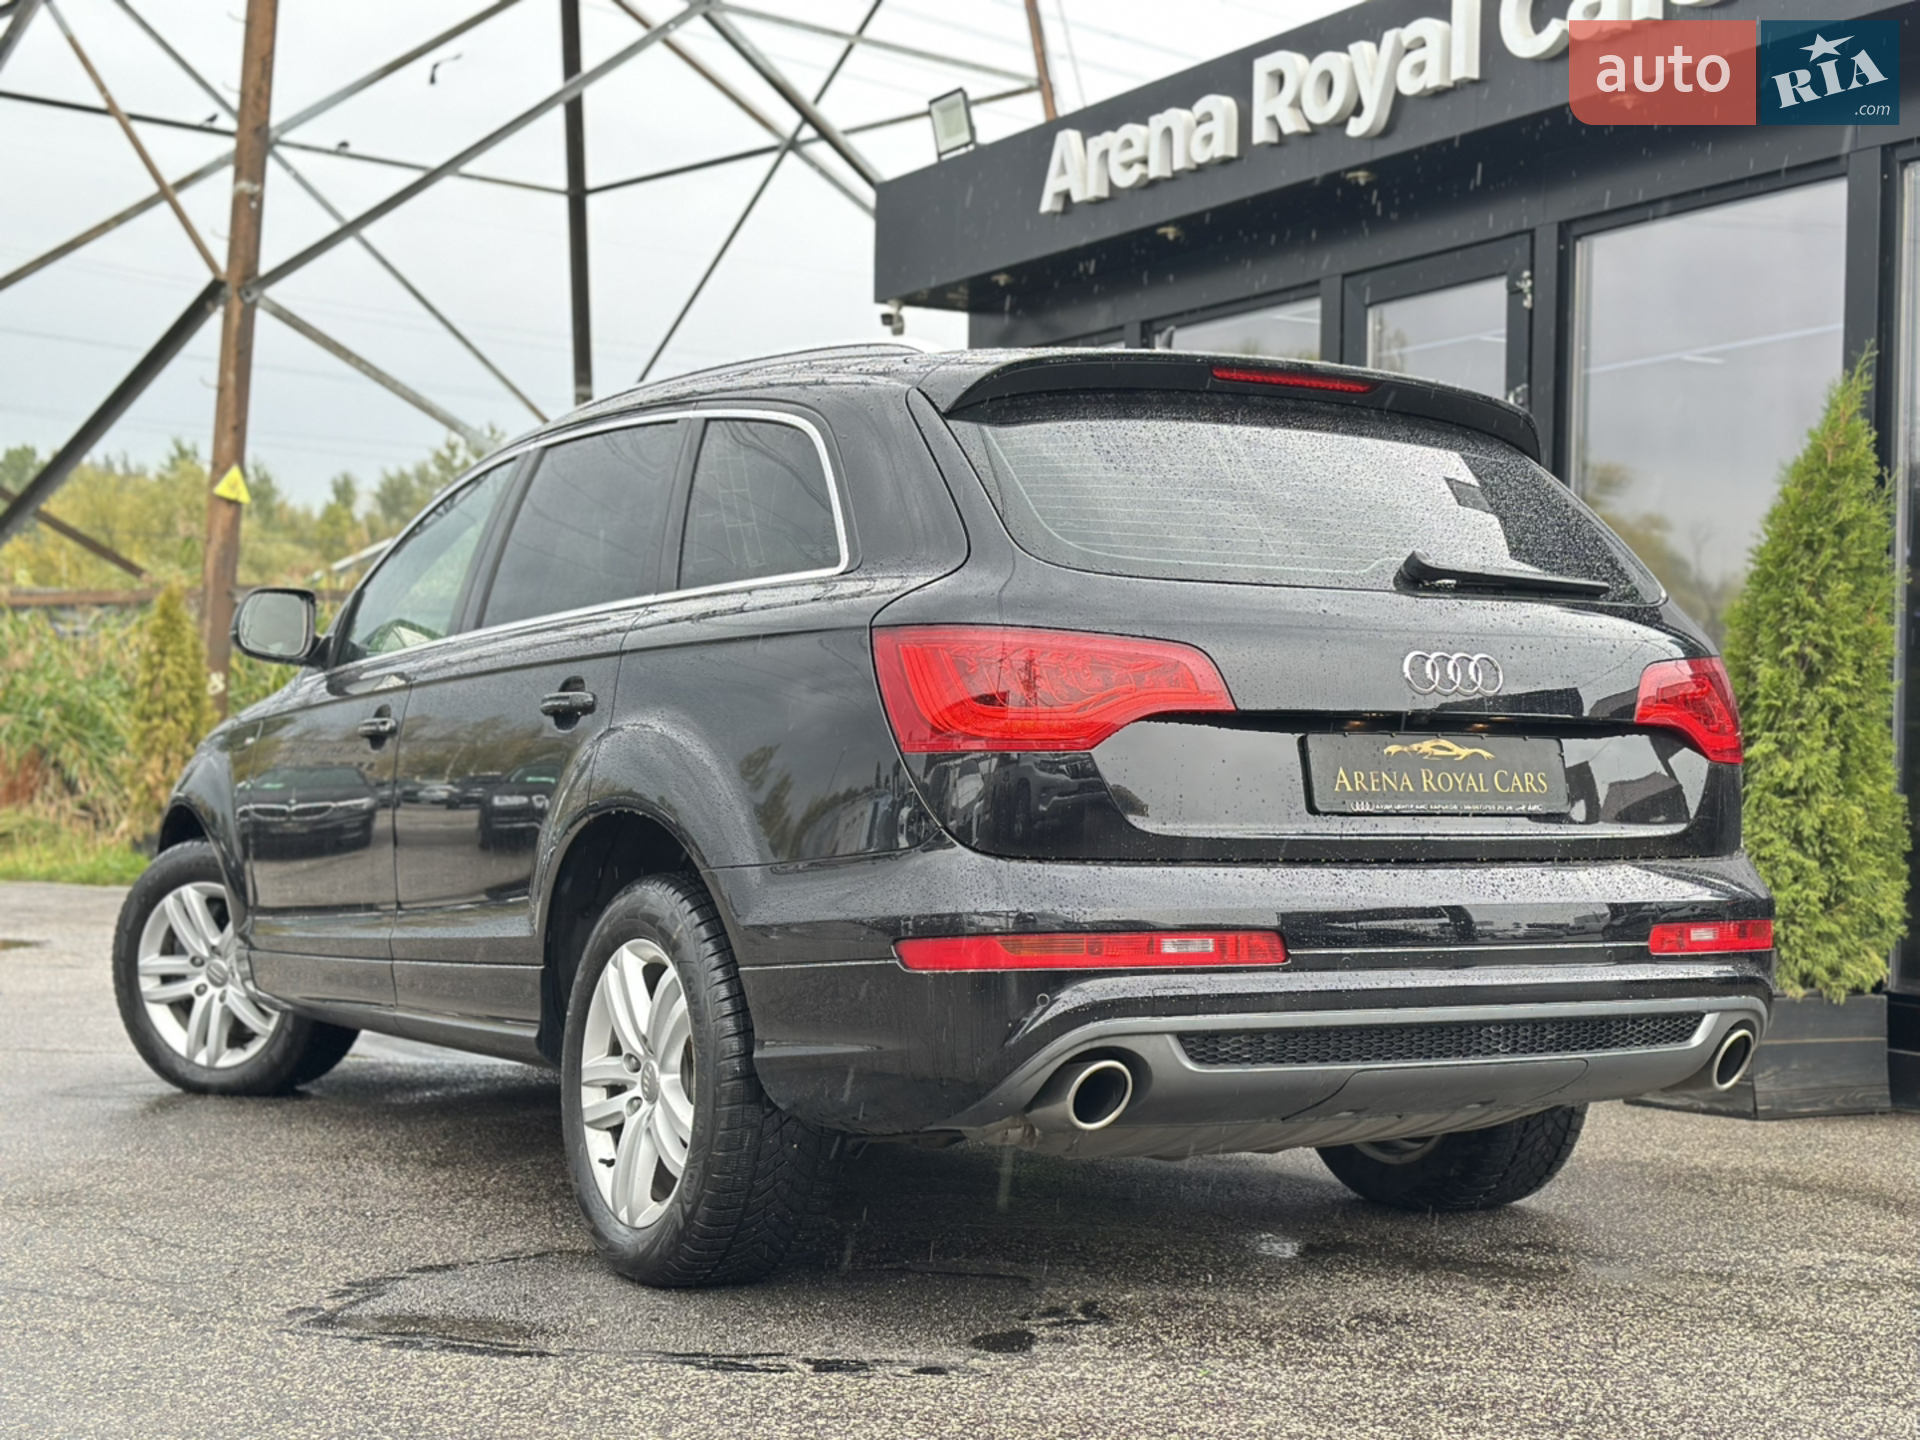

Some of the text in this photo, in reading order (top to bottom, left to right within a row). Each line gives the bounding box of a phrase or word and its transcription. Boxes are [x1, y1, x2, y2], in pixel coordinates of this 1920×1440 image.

[1039, 94, 1238, 214] Arena
[1252, 0, 1481, 146] Royal
[1334, 766, 1548, 794] ARENA ROYAL CARS
